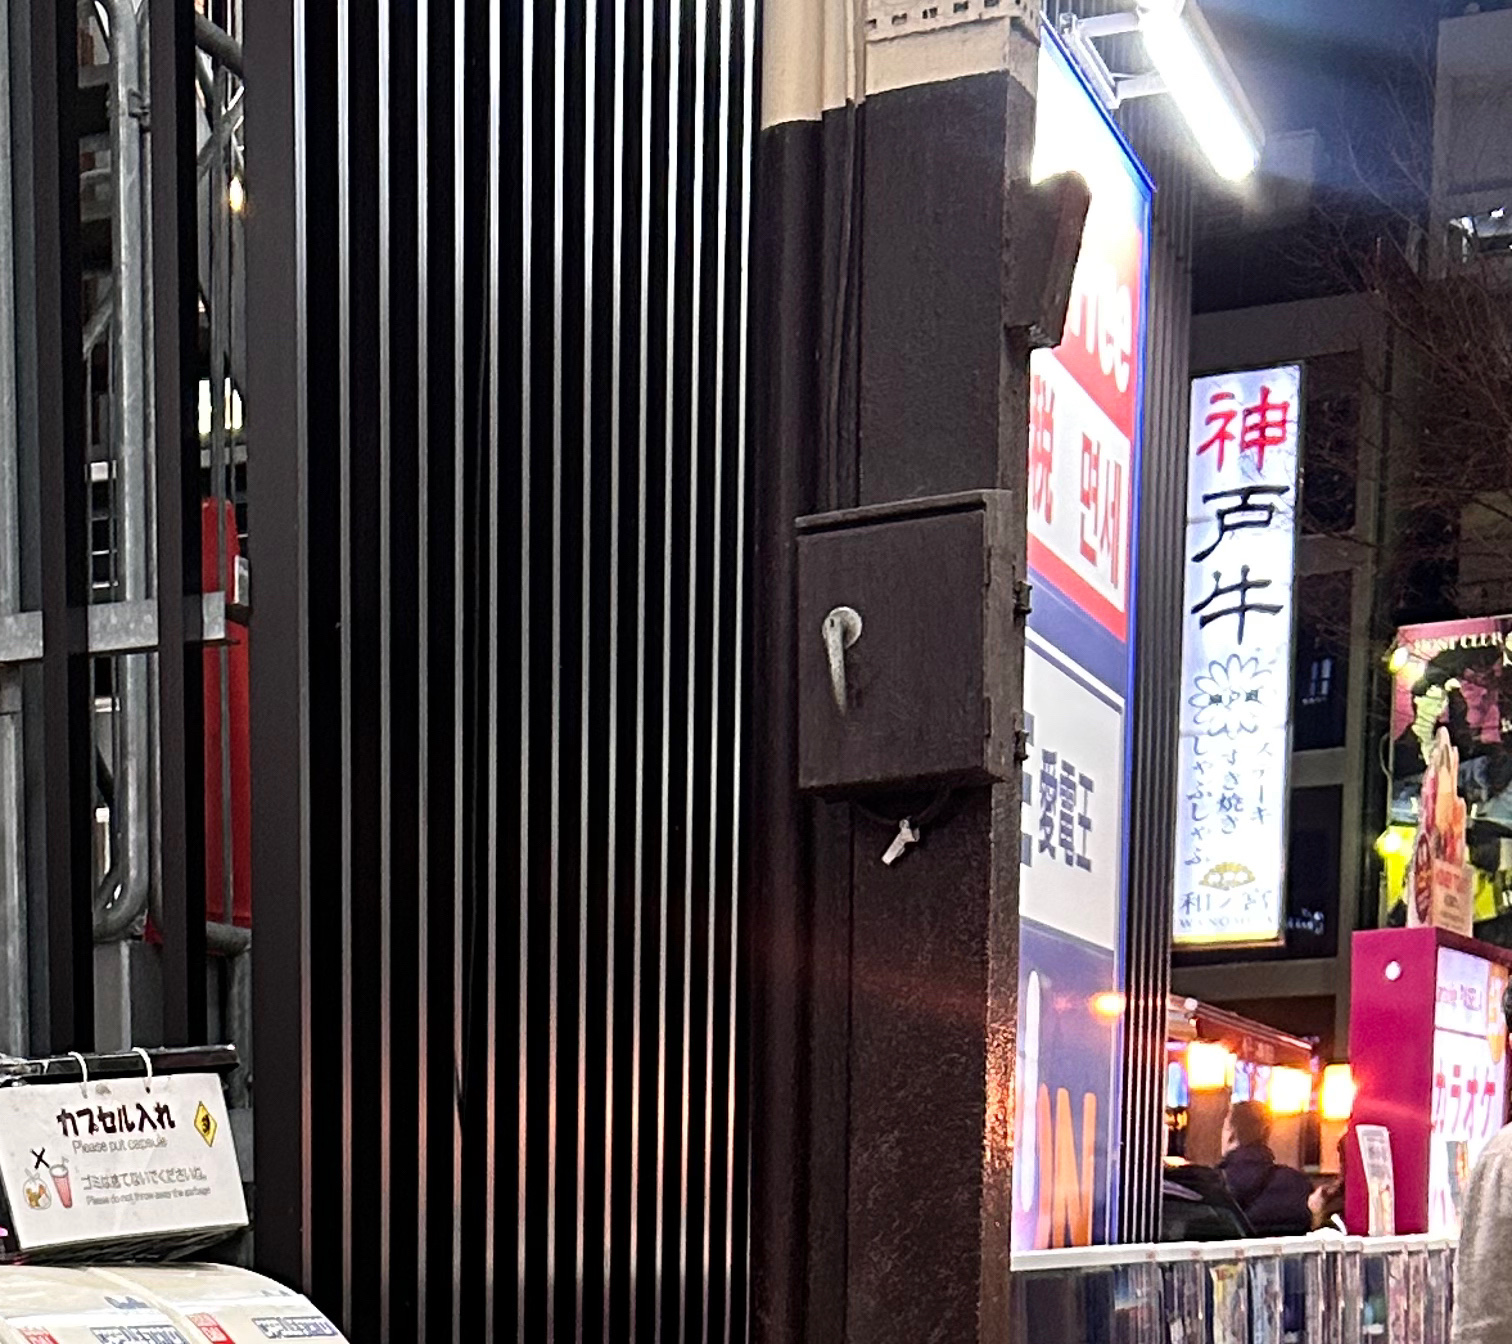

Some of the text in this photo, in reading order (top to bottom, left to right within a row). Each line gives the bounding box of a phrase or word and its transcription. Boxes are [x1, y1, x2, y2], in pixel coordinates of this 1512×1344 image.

[1191, 386, 1290, 645] 神戸牛
[56, 1102, 176, 1137] カプセル入れ
[73, 1139, 108, 1154] Please
